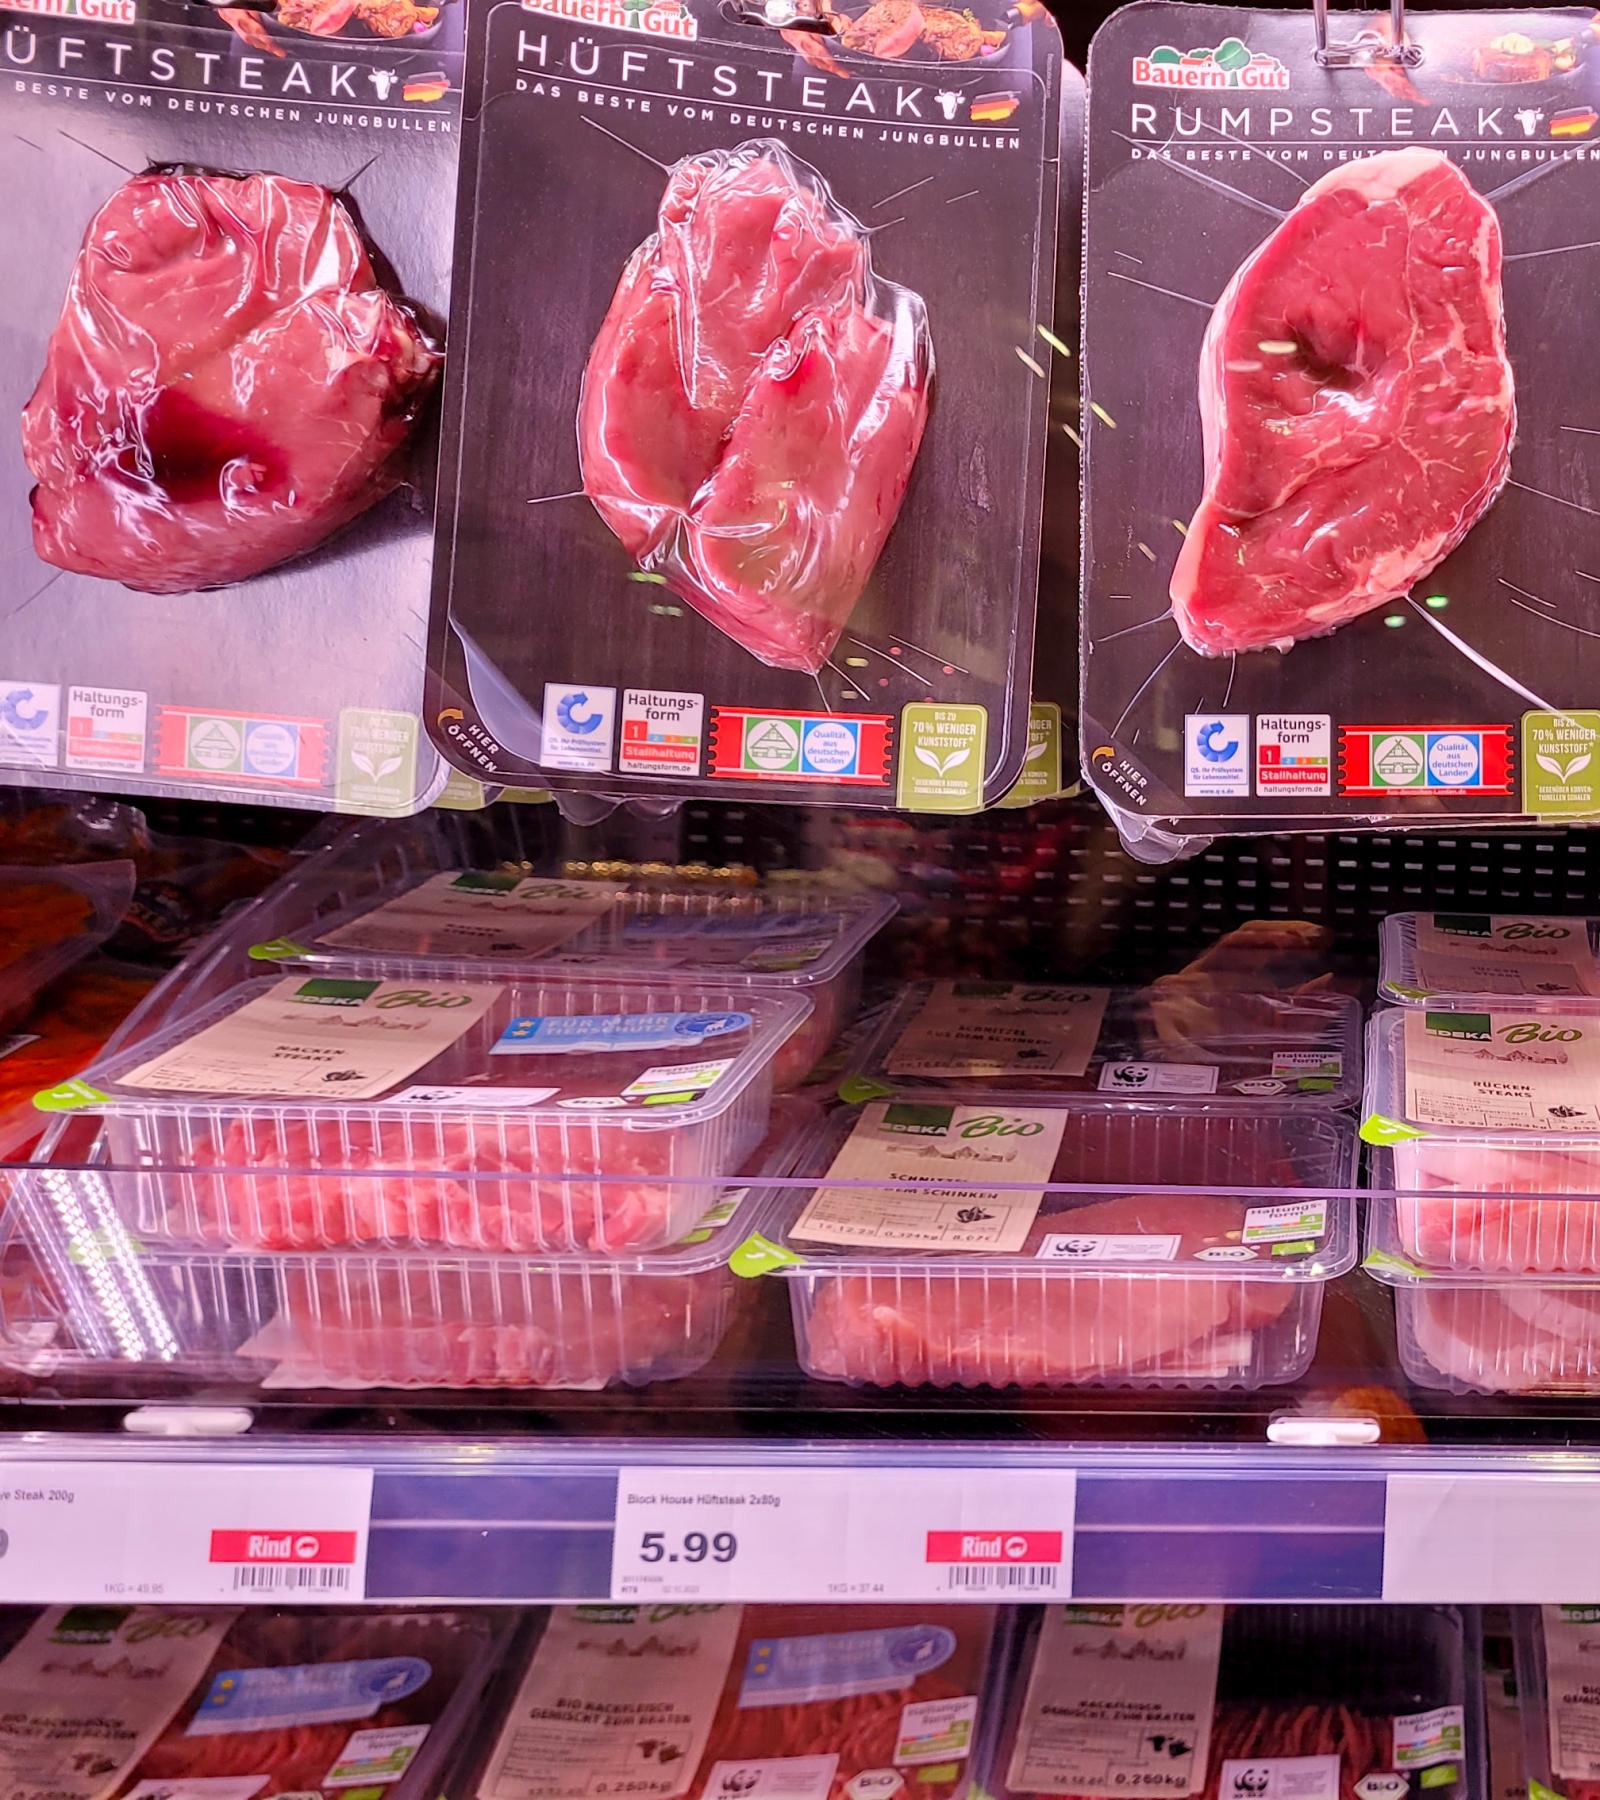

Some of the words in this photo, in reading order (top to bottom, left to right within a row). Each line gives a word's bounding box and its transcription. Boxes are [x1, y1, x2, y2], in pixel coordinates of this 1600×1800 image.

[643, 11, 694, 38] Gut
[6, 26, 357, 98] ÜFTSTEAK
[518, 30, 923, 117] HÜFTSTEAK
[1136, 60, 1227, 87] Bauern
[1242, 69, 1287, 89] Gut
[16, 81, 89, 100] BESTE
[105, 91, 152, 107] VOM
[168, 98, 300, 122] DEUTSCHEN
[315, 112, 452, 132] JUNGBULLEN
[516, 79, 560, 97] DAS
[578, 91, 651, 112] BESTE
[667, 105, 713, 121] VOM
[730, 113, 864, 139] DEUTSCHEN
[879, 130, 1020, 149] JUNGBULLEN
[1131, 103, 1503, 136] RUMPSTEAK
[1131, 148, 1172, 161] DAS
[1186, 149, 1251, 161] BESTE
[1266, 149, 1308, 161] VOM
[73, 690, 143, 709] Haltungs-
[628, 693, 699, 712] Haltungs-
[90, 705, 125, 719] form
[645, 707, 680, 721] form
[934, 711, 945, 721] BIS
[946, 712, 957, 721] ZU
[935, 723, 977, 736] WENIGER
[1260, 718, 1326, 733] Haltungs-
[1553, 718, 1564, 727] BIS
[631, 725, 639, 738] 1
[813, 730, 847, 740] Qualität
[1277, 731, 1310, 744] form
[1532, 729, 1554, 740] 70%
[1556, 729, 1596, 740] WENIGER
[468, 723, 498, 755] HIER
[447, 723, 497, 773] ÖFFNEN
[625, 746, 695, 760] Stallhaltung
[807, 747, 850, 758] deutschen
[1436, 743, 1469, 752] Qualität
[813, 756, 845, 765] Landen
[1265, 750, 1272, 762] 1
[627, 761, 692, 773] haltungsform.de
[1432, 760, 1473, 769] deutschen
[1119, 760, 1149, 788] HIER
[1261, 770, 1326, 783] Stallhaltung
[1438, 769, 1469, 777] Landen
[1101, 761, 1147, 807] ÖFFNEN
[1263, 785, 1323, 794] haltungsform.de
[1496, 922, 1571, 940] Bio
[549, 1017, 593, 1028] FÜR
[602, 1016, 669, 1027] MEHR
[1430, 1028, 1493, 1040] EDEKA
[1496, 1022, 1583, 1043] Bio
[1477, 1088, 1533, 1098] STEAKS
[956, 1115, 1045, 1139] Bio
[923, 1189, 999, 1200] SCHINKEN
[14, 1489, 45, 1501] Steak
[48, 1489, 75, 1504] 200g
[627, 1493, 656, 1505] Block
[660, 1493, 693, 1505] House
[696, 1492, 746, 1505] Hüftsteak
[248, 1534, 291, 1559] Rind
[639, 1531, 738, 1563] 5.99
[961, 1536, 1001, 1558] Rind
[1366, 1781, 1399, 1791] BIO
